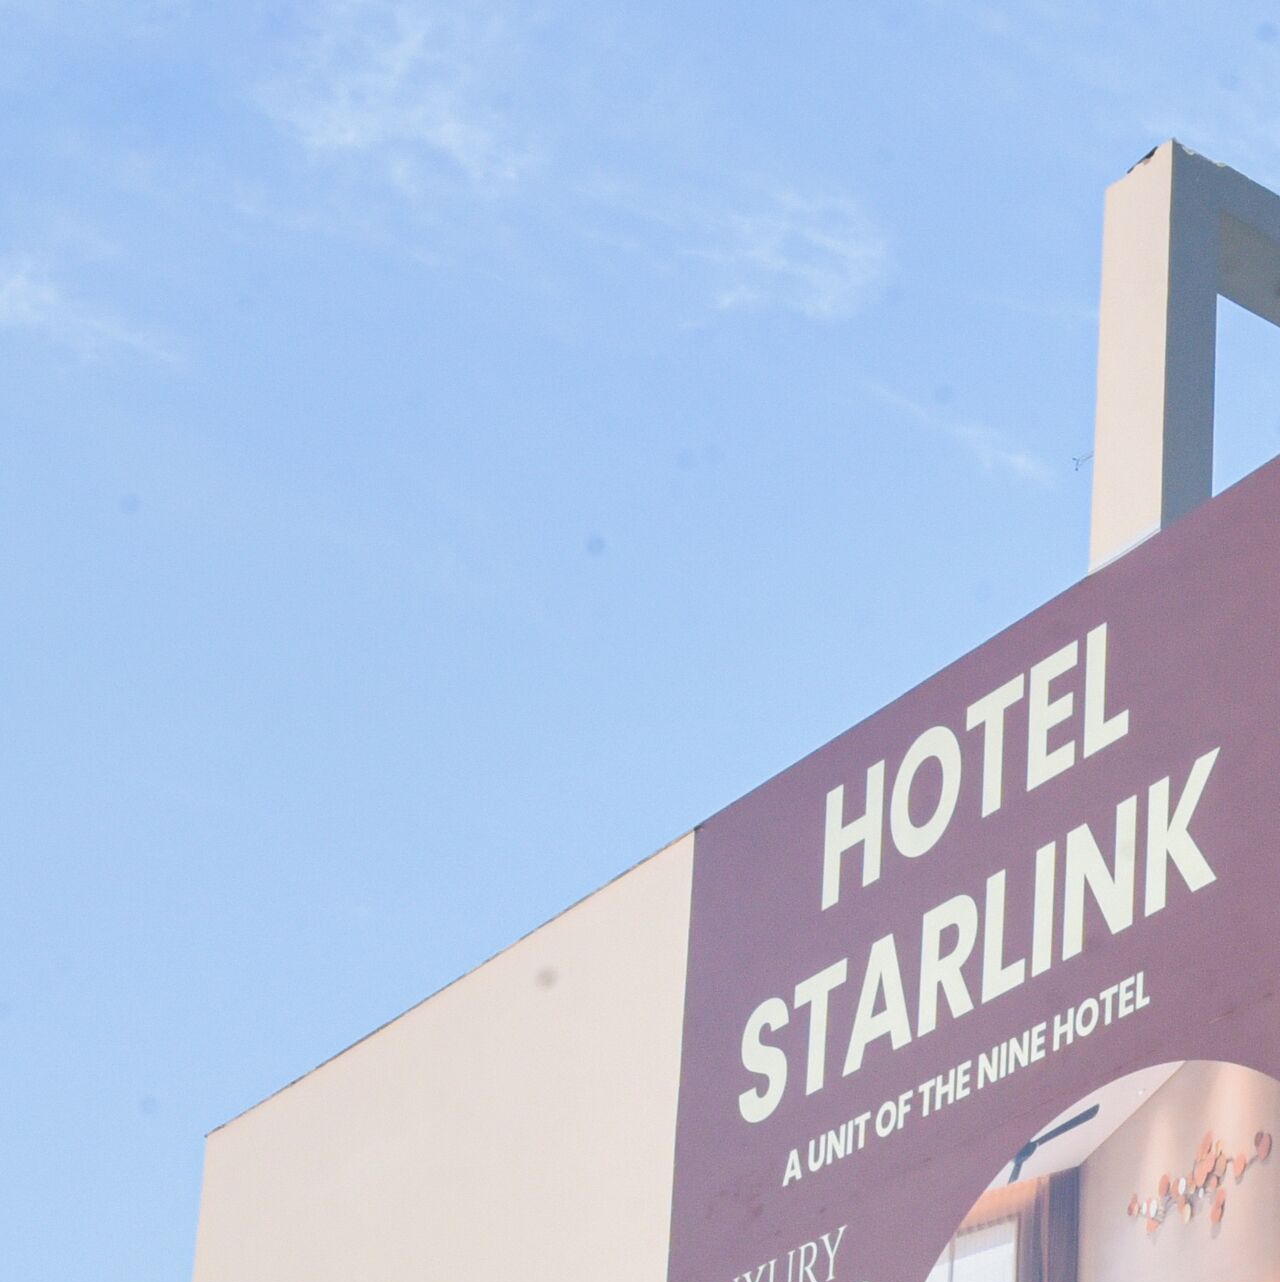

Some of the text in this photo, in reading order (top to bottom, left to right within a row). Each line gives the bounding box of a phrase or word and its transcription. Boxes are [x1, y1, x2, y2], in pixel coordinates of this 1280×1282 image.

[821, 621, 1130, 912] HOTEL
[738, 746, 1221, 1124] STARLINK
[782, 971, 1150, 1188] A UNIT OF THE NINE HOTEL
